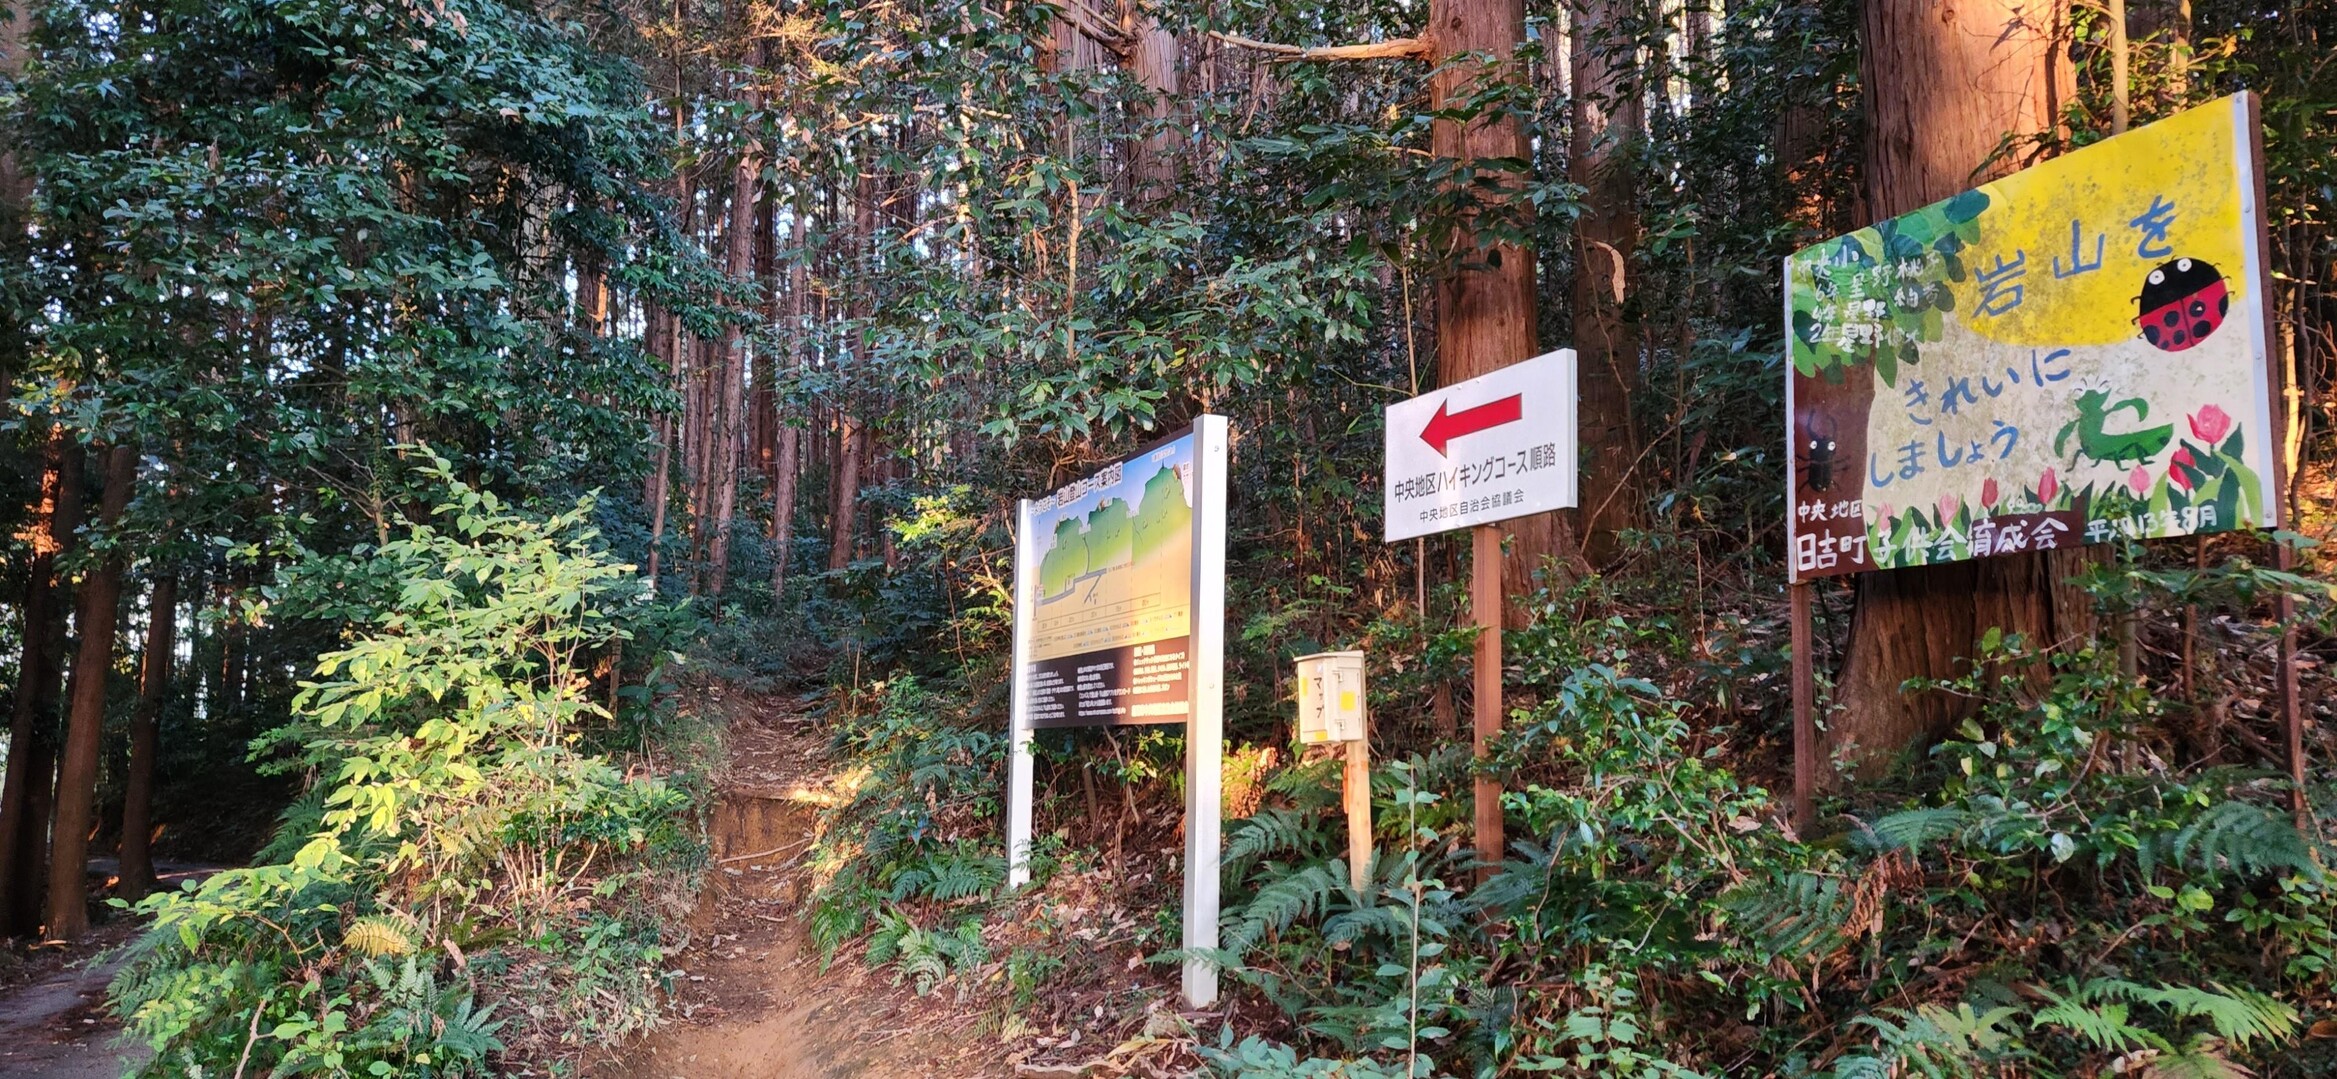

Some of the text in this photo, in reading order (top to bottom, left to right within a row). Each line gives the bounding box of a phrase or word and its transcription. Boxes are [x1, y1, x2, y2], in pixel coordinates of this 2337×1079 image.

[1798, 244, 1860, 281] 中央小
[1972, 195, 2176, 319] 岩山を
[1815, 283, 1839, 303] 6年
[1812, 303, 1838, 323] 4年
[1809, 322, 1841, 343] 2年
[1905, 348, 2072, 426] きれいに
[1394, 441, 1556, 503] 中央地区ハイキングコース順路
[1871, 420, 2020, 488] しましょう
[1419, 488, 1525, 523] 中央地区自治会協議会
[1797, 499, 1863, 521] 中央地区
